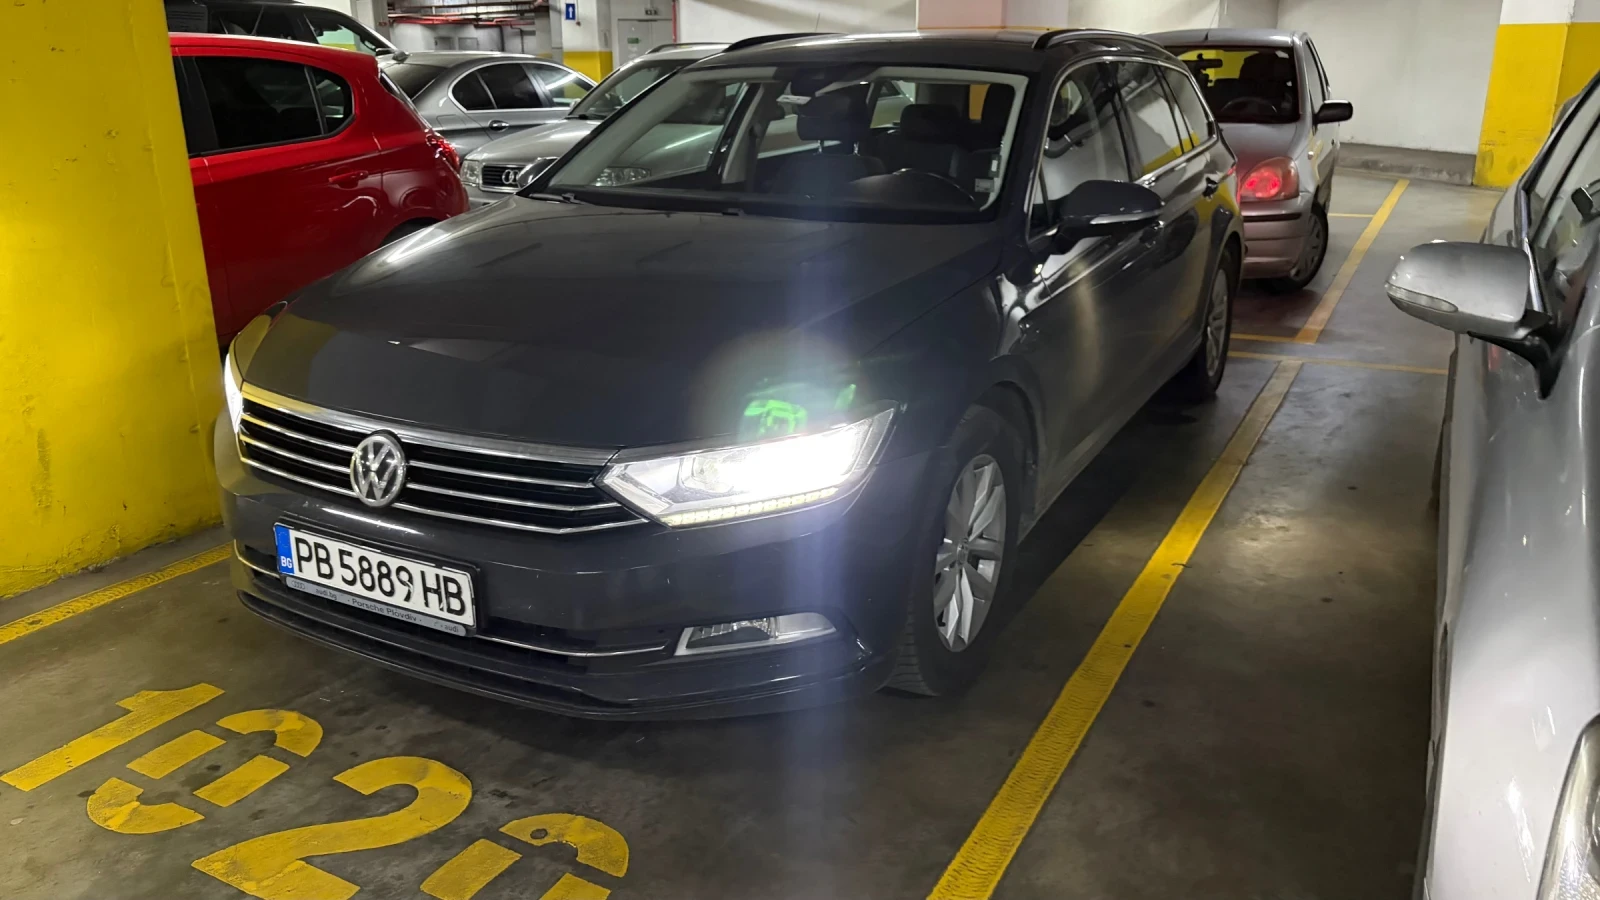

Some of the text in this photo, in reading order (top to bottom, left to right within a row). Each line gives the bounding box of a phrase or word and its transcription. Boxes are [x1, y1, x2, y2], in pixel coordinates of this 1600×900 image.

[351, 434, 404, 506] VW
[280, 555, 293, 569] BG
[294, 536, 466, 616] PB 5889 HB
[351, 598, 385, 613] Porsche
[386, 607, 417, 622] Plovdiv
